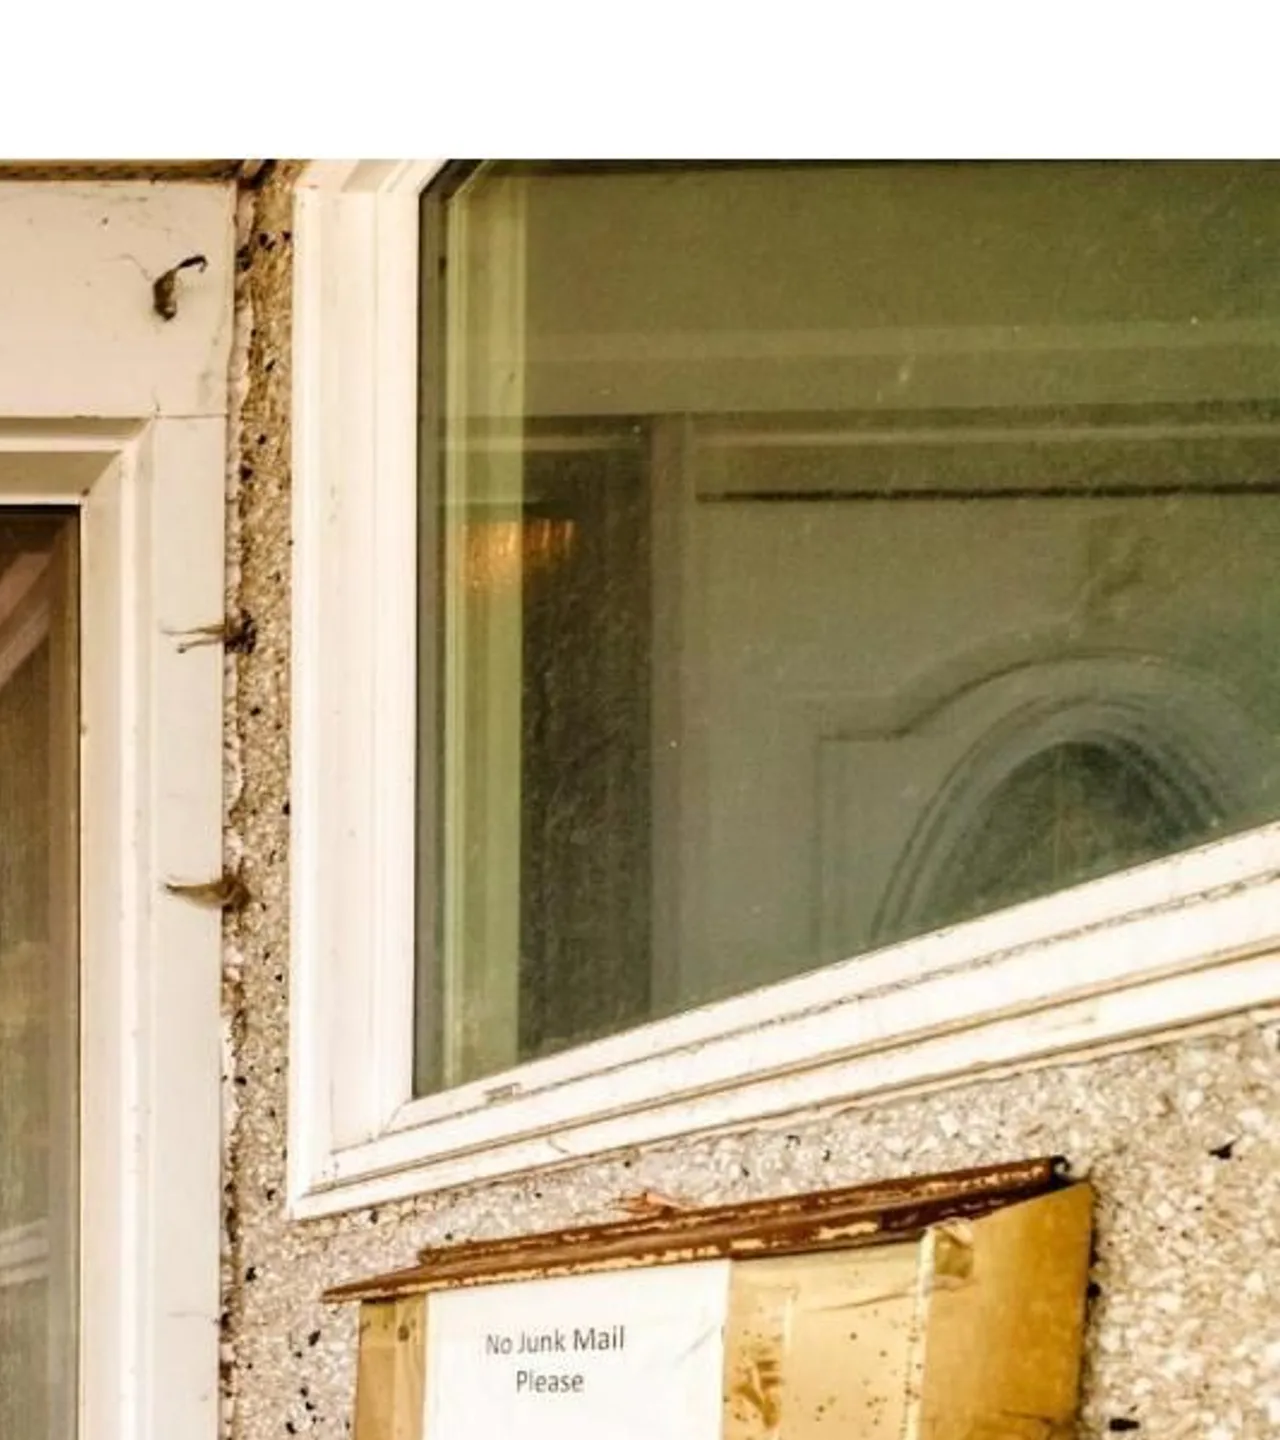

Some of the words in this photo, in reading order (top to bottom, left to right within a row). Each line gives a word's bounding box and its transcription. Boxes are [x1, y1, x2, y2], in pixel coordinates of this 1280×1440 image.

[486, 1333, 513, 1355] No
[517, 1327, 566, 1354] Junk
[573, 1324, 625, 1351] Mail
[516, 1369, 585, 1393] Please
